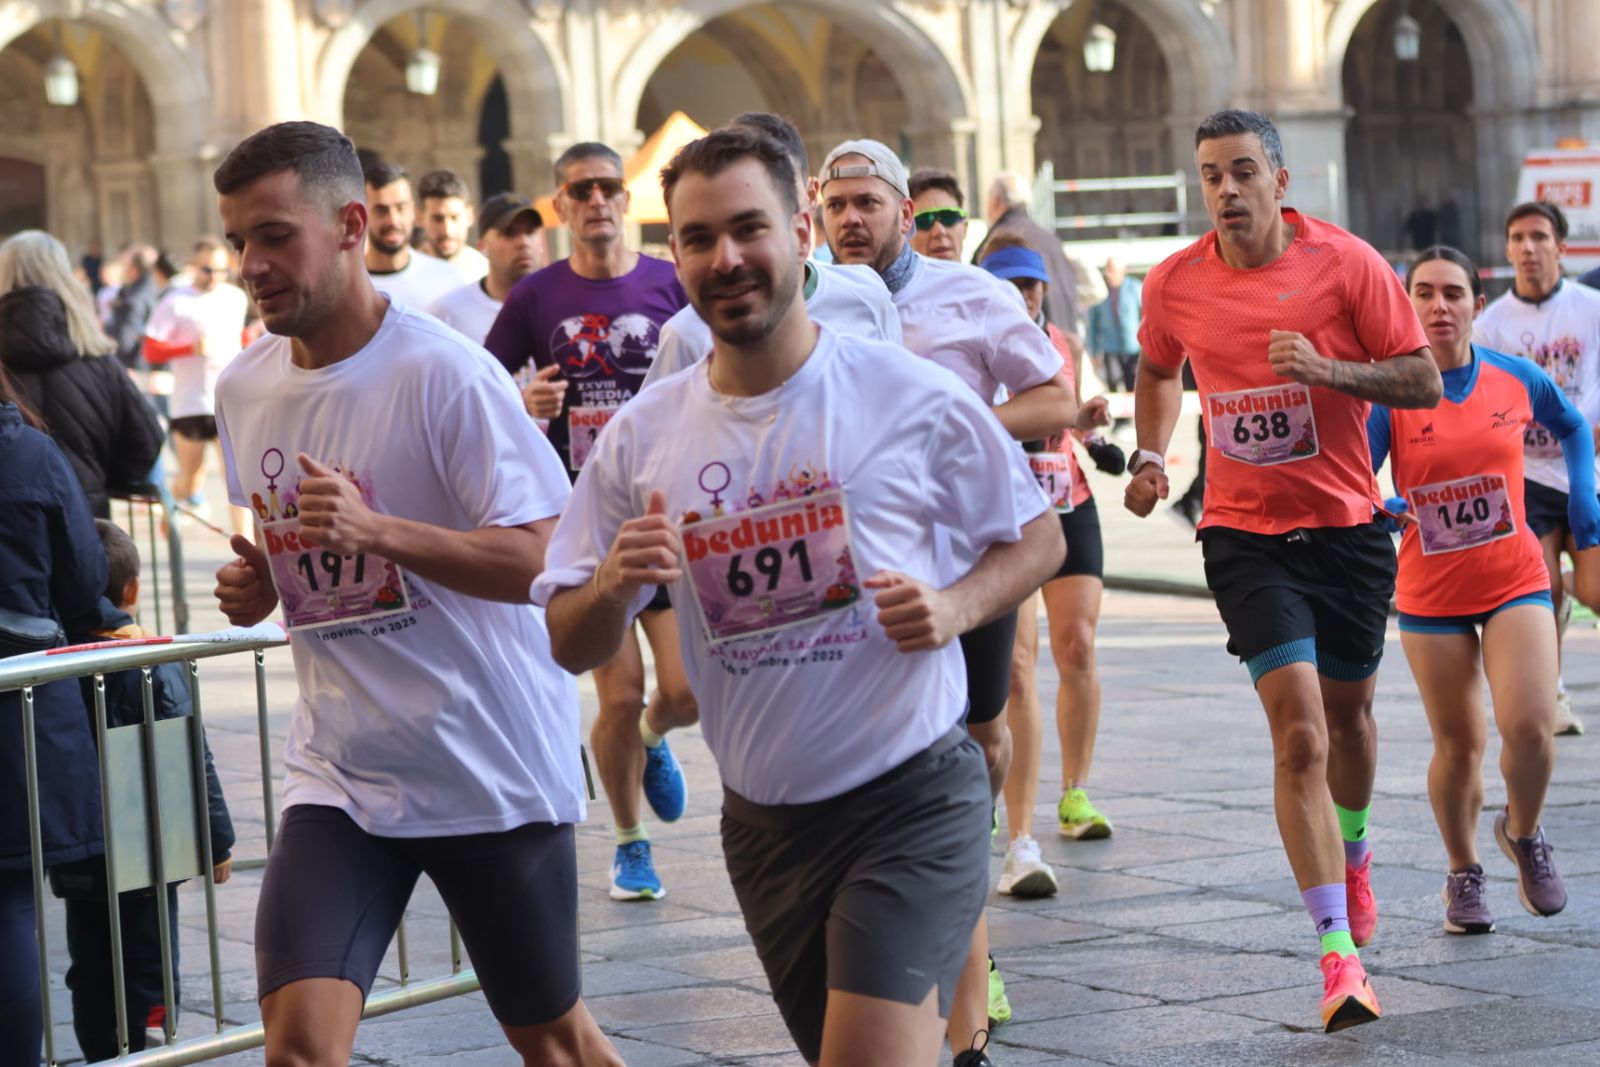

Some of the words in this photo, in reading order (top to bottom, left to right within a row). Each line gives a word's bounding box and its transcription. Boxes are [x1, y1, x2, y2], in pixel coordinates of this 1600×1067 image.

[577, 381, 617, 391] XXVIII
[581, 389, 633, 401] MEDIA
[1210, 389, 1308, 417] bedunia
[1233, 411, 1291, 444] 638
[1411, 476, 1504, 507] bedunia
[1437, 497, 1490, 529] 140
[683, 503, 844, 563] bedunia
[727, 539, 813, 597] 691
[389, 616, 417, 632] 2025
[812, 650, 844, 664] 2025
